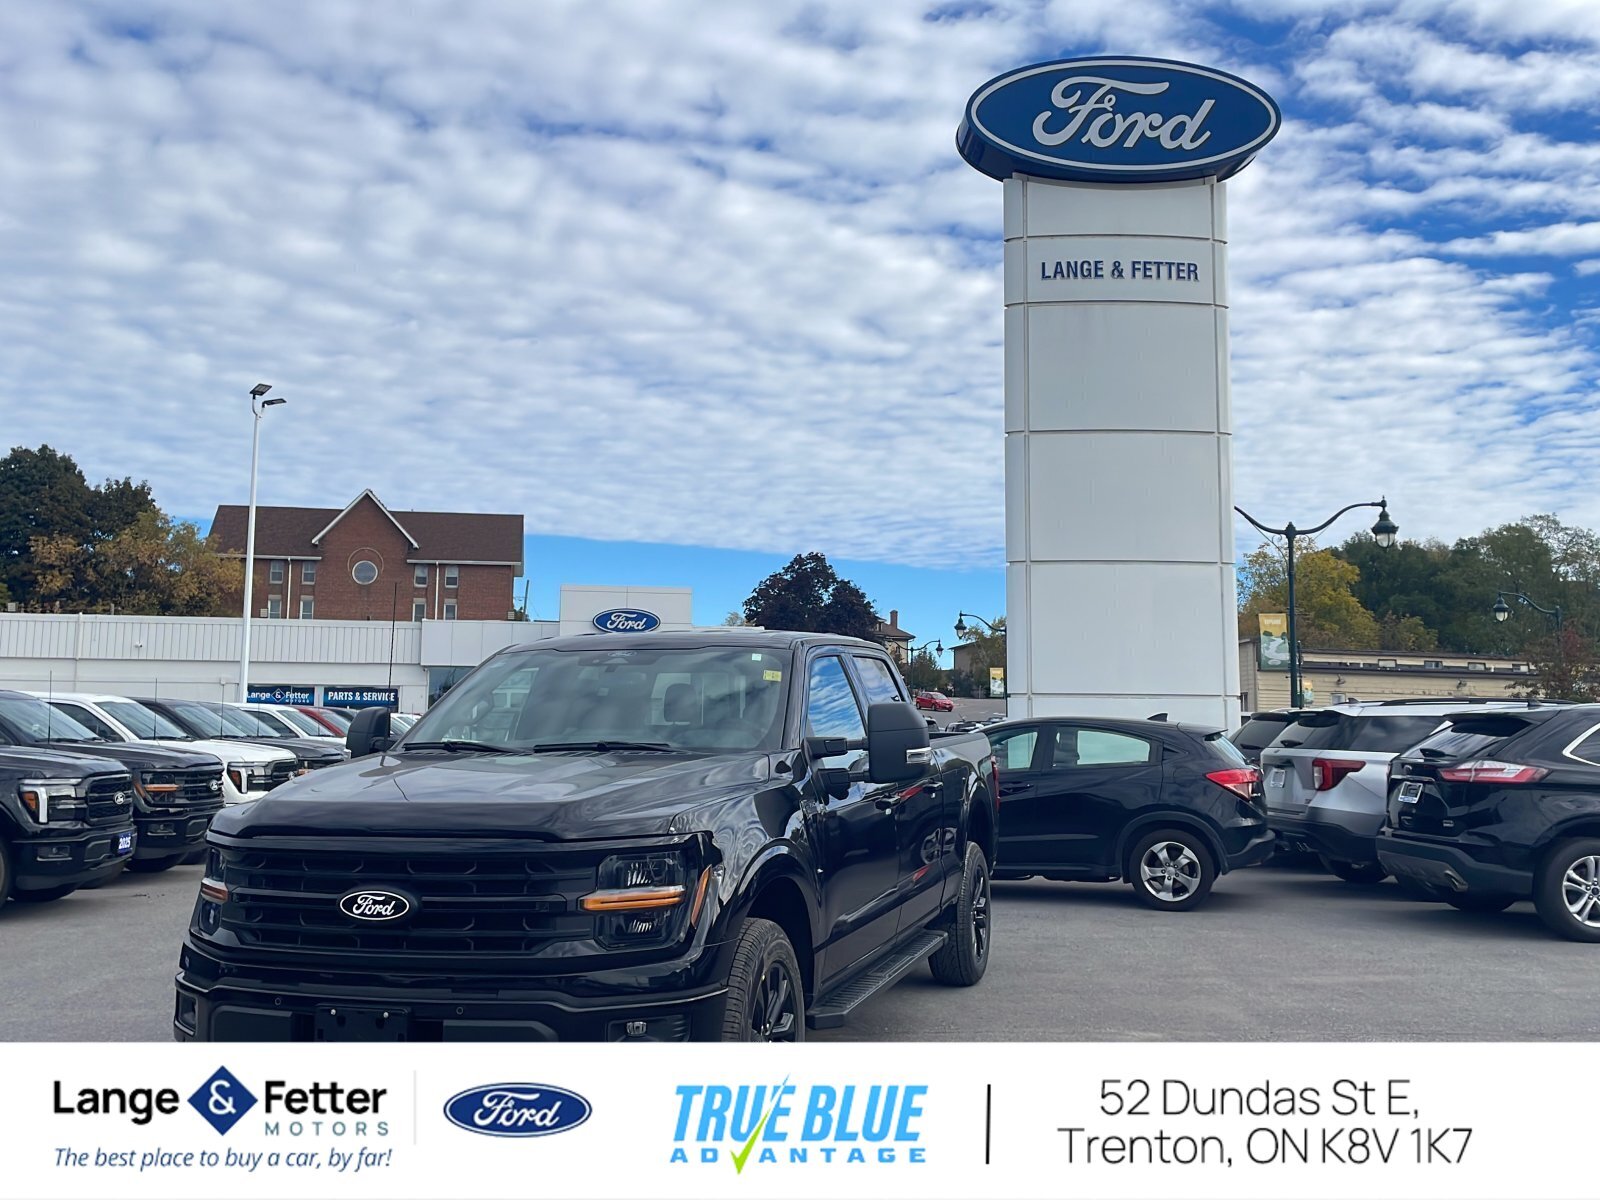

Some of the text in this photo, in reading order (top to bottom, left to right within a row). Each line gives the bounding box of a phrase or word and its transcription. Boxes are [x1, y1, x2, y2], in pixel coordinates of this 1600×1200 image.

[1032, 76, 1216, 150] Ford
[1041, 260, 1199, 281] LANGE & FETTER
[606, 612, 647, 630] Ford
[328, 691, 395, 702] PARTS & SERVICE
[118, 836, 131, 850] 2025
[353, 894, 396, 916] Ford
